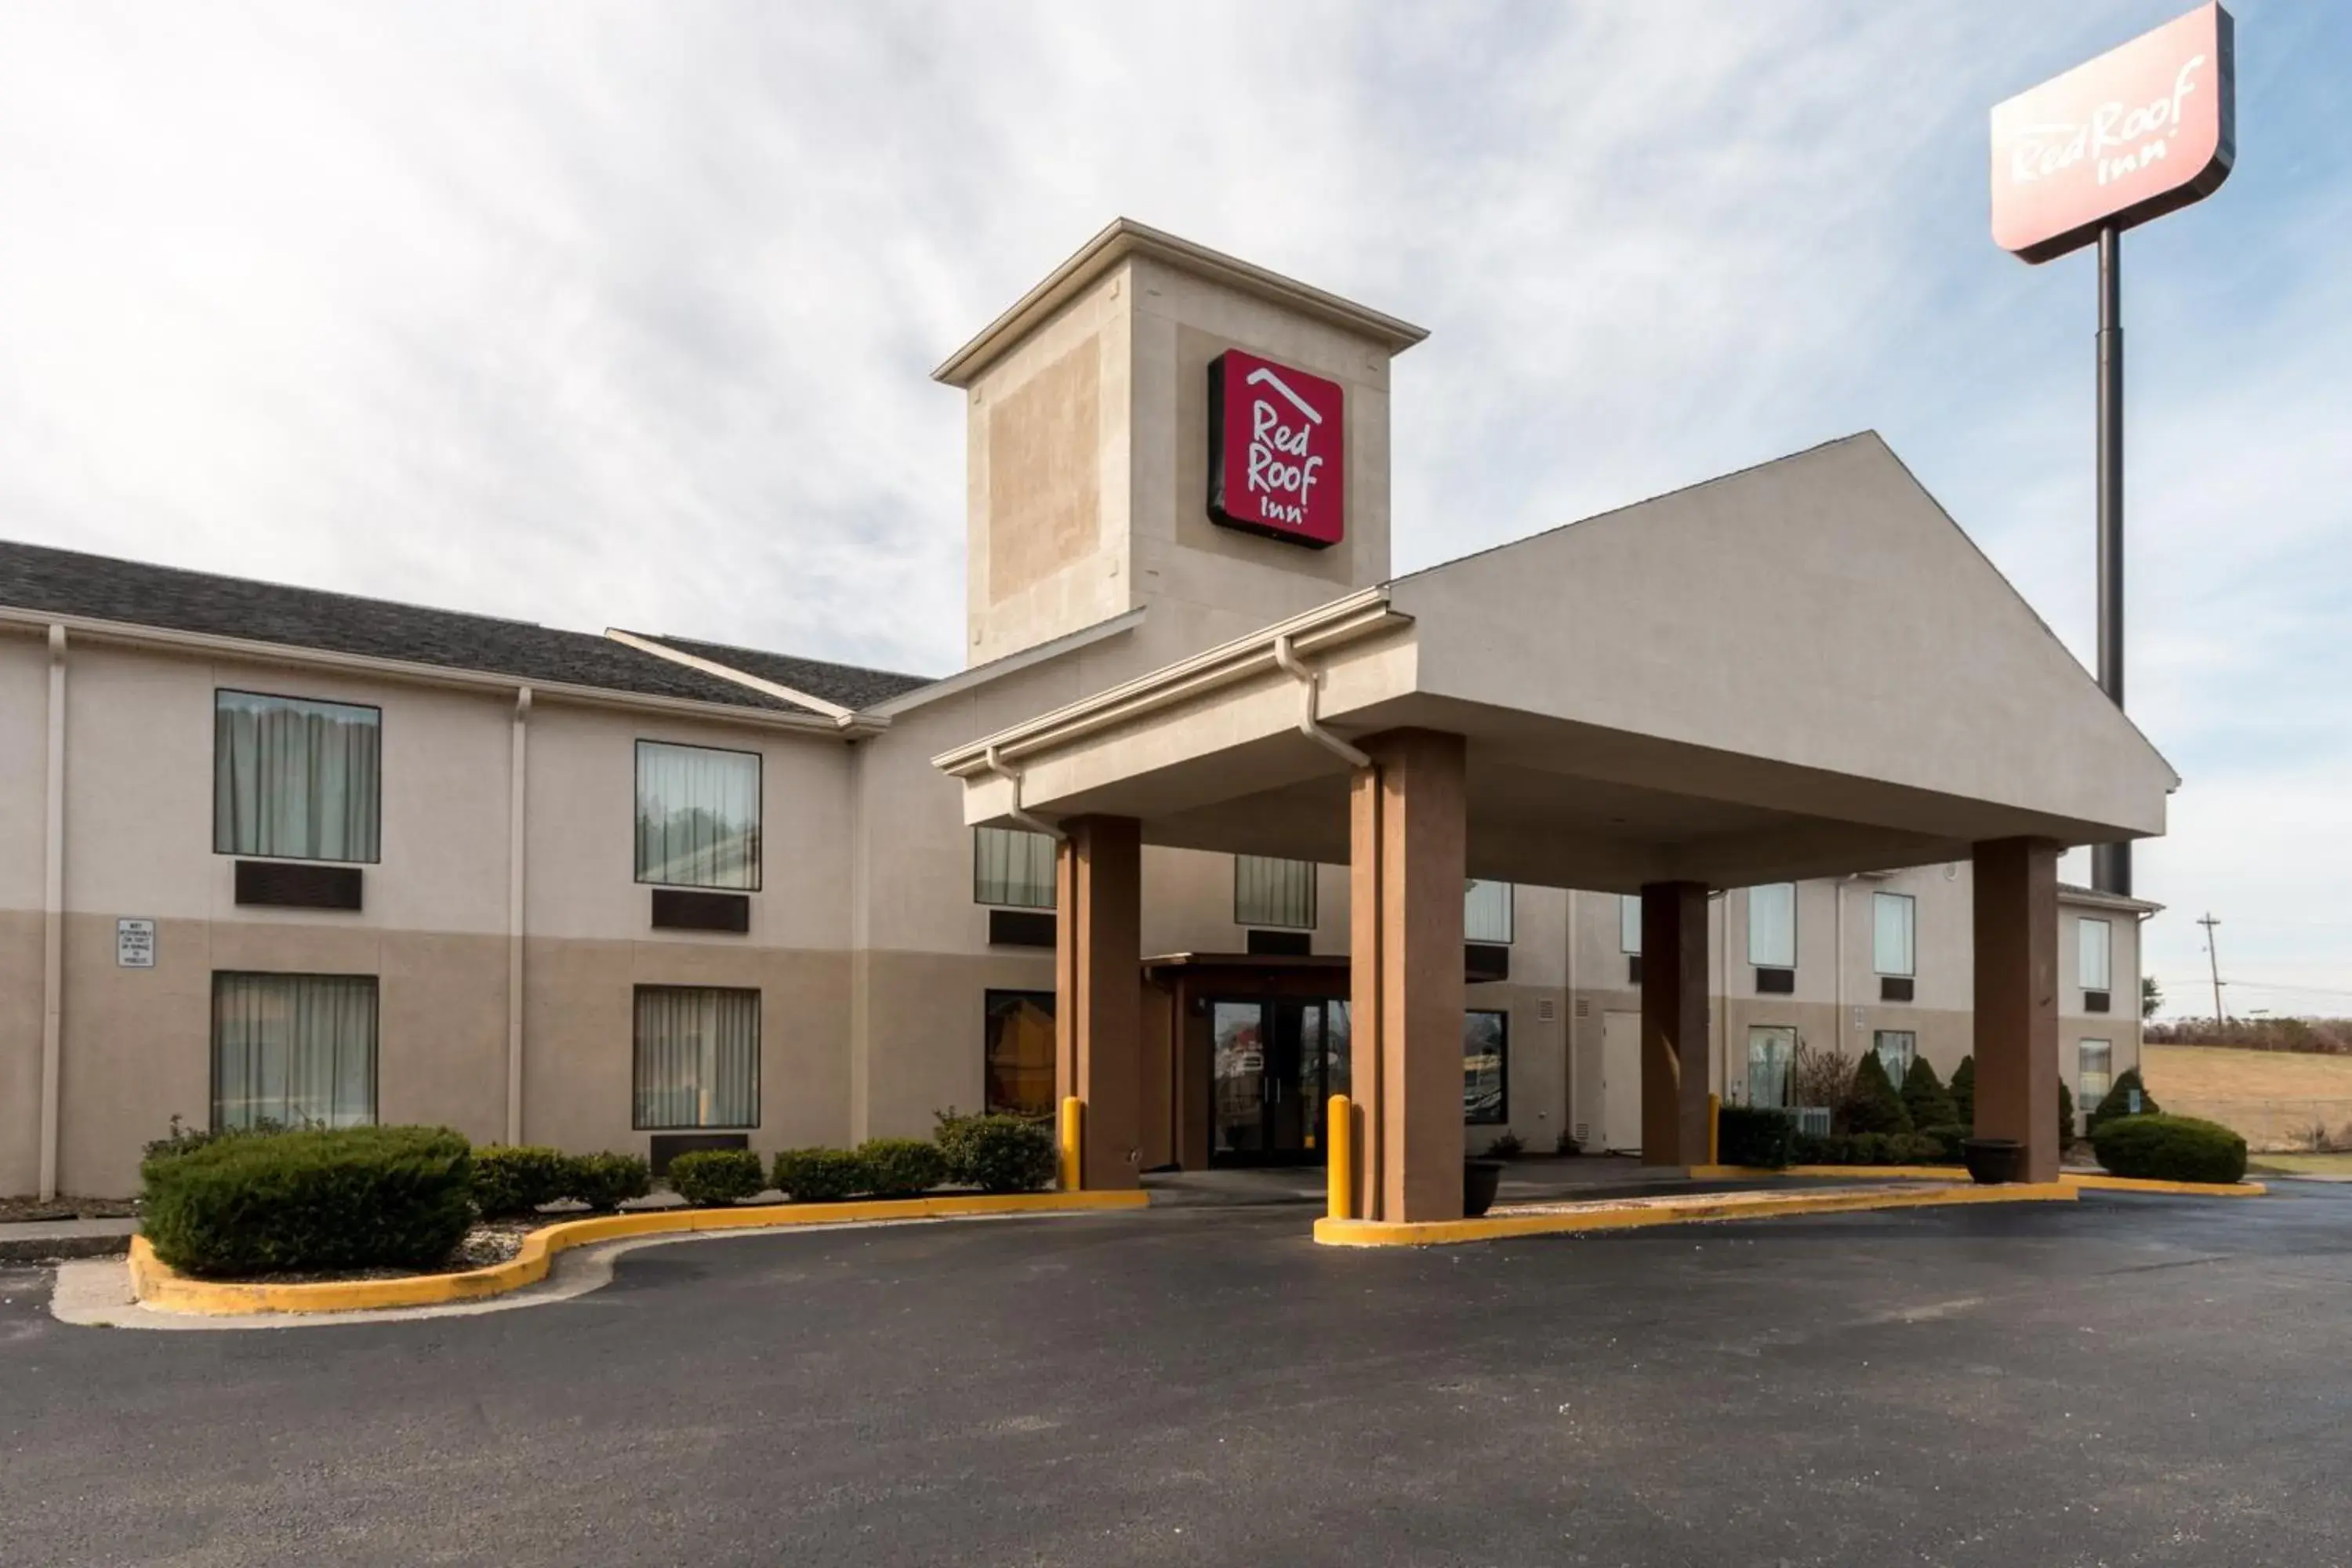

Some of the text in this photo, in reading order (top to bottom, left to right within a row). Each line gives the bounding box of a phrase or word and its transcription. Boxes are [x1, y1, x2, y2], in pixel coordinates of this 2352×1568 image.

[2012, 55, 2205, 183] Red Roof
[2098, 139, 2166, 185] Inn
[1254, 399, 1310, 456] Red
[1247, 442, 1323, 505] Roof
[1261, 495, 1302, 524] Inn
